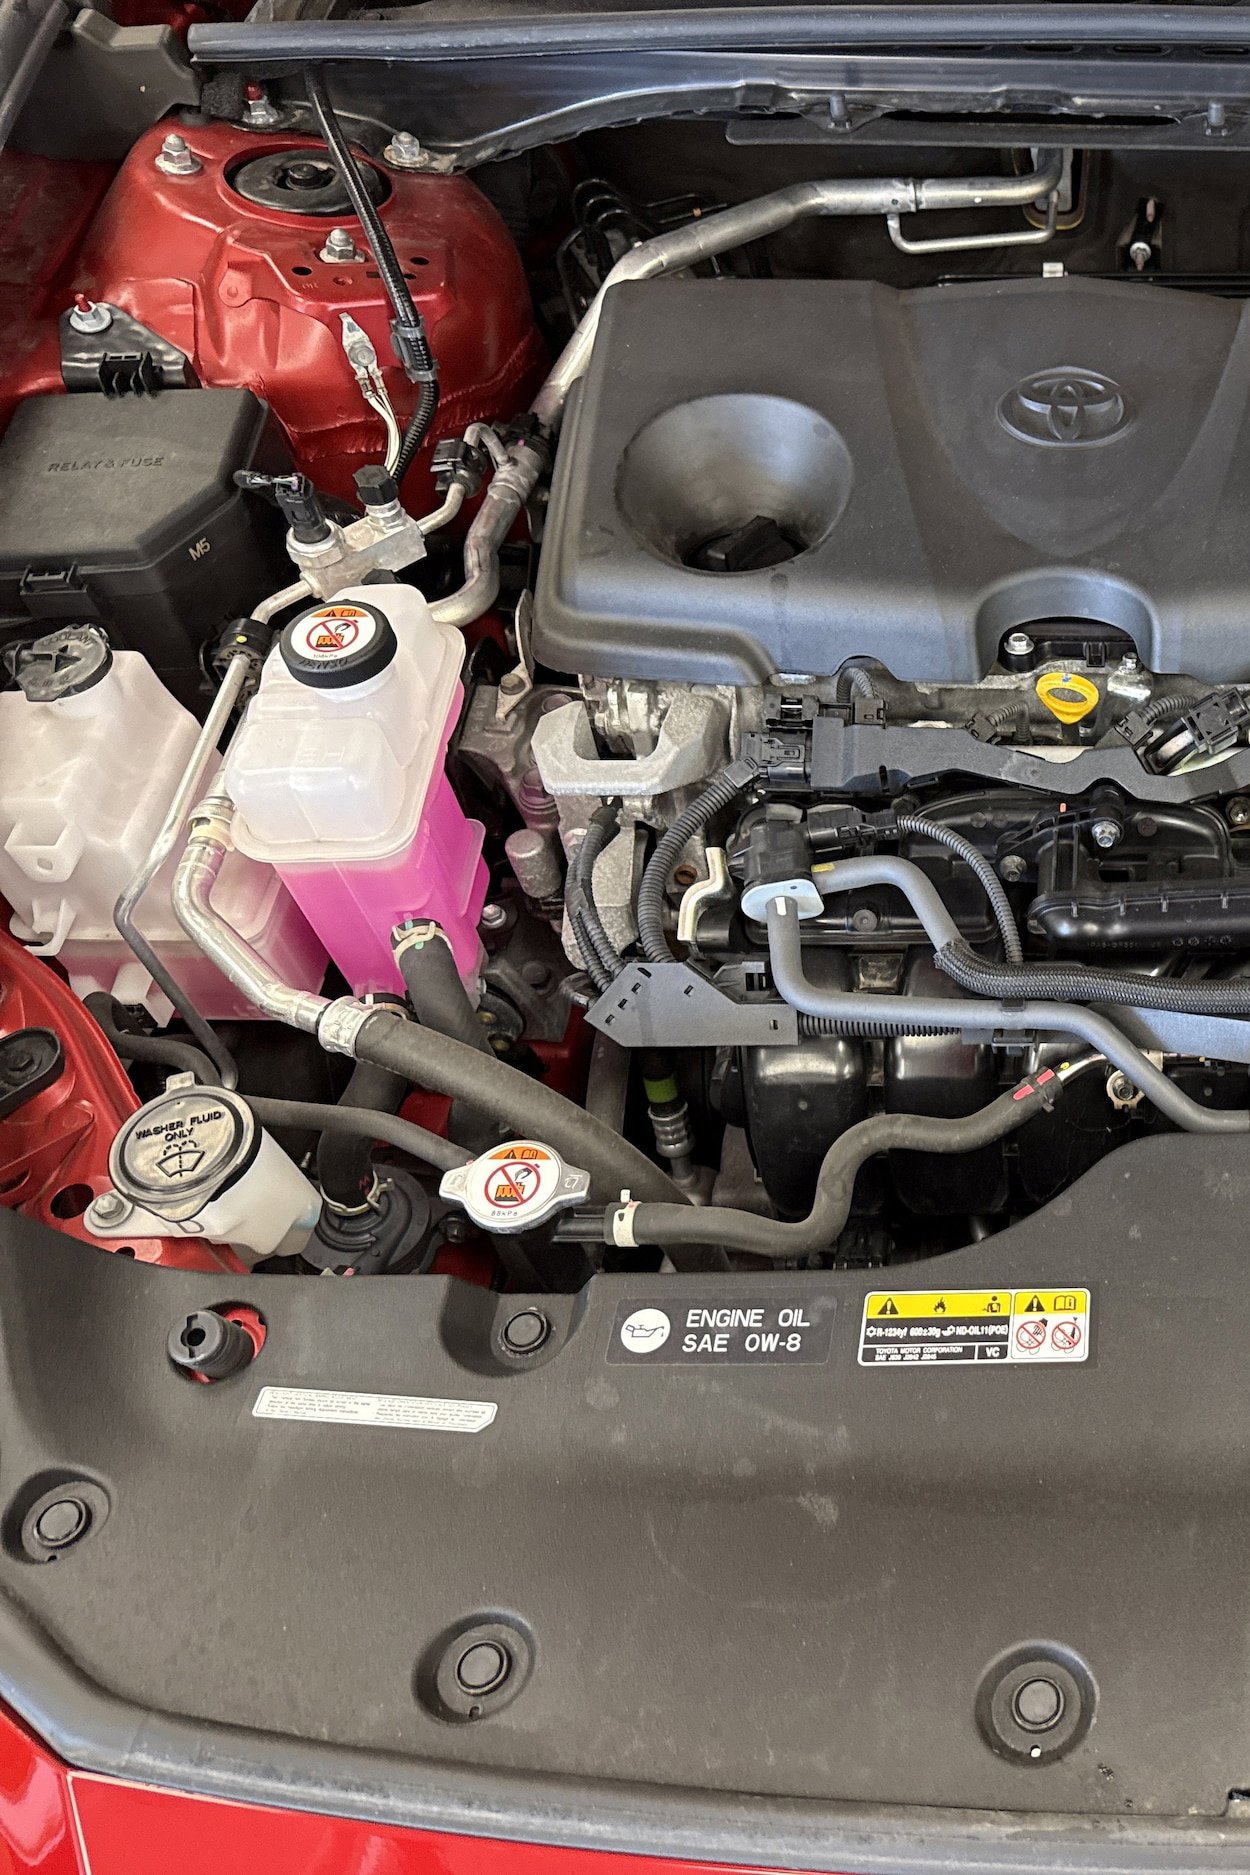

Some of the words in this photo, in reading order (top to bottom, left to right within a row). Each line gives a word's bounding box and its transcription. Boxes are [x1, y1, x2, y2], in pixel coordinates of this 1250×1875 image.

[48, 460, 103, 473] RELAY
[120, 457, 165, 468] FUSE
[188, 537, 211, 561] M5
[135, 1121, 184, 1140] WASHER
[190, 1111, 223, 1126] FLUID
[164, 1127, 194, 1142] ONLY
[686, 1308, 765, 1328] ENGINE
[778, 1308, 810, 1327] OIL
[682, 1333, 730, 1352] SAE
[744, 1333, 801, 1352] 0W-8
[876, 1347, 898, 1355] TOYOTA
[922, 1346, 963, 1354] CORPORATION
[985, 1347, 1000, 1357] VC
